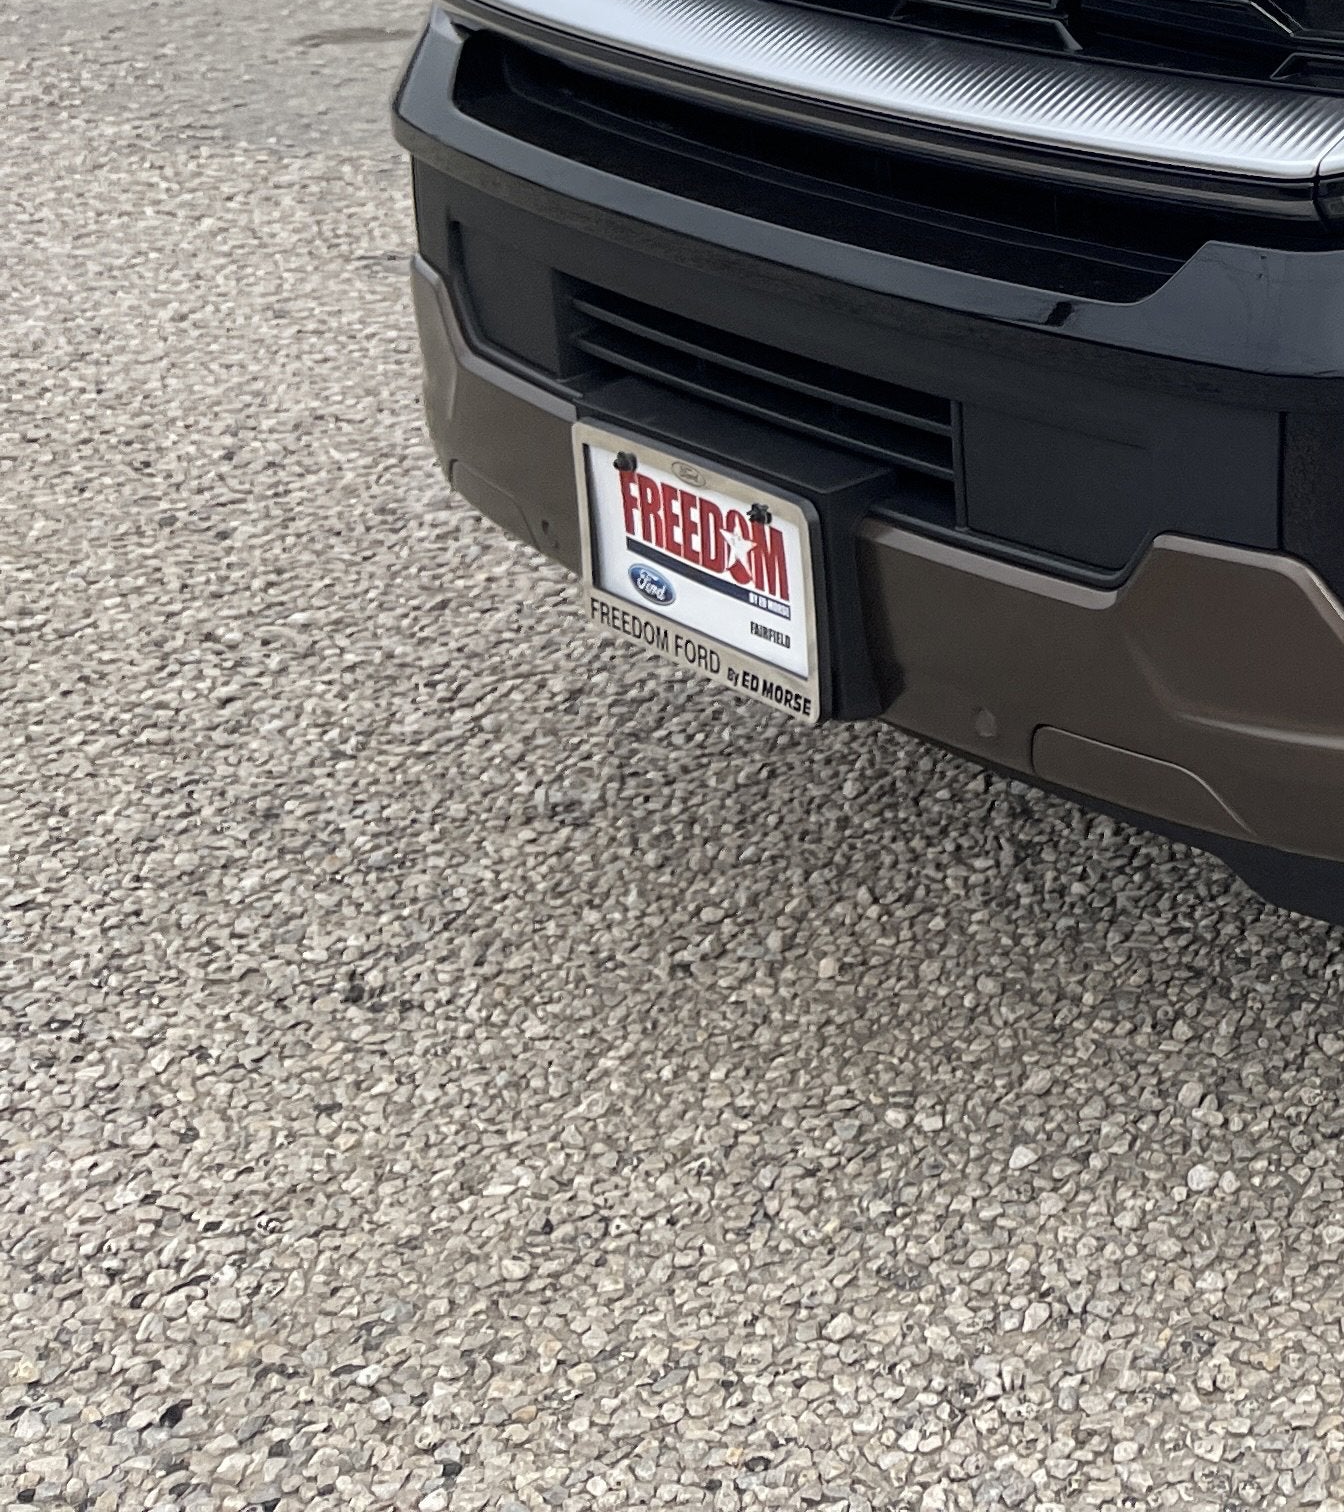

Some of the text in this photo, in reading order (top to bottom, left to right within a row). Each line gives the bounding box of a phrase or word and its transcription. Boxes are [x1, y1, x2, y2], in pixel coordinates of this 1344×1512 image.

[619, 470, 790, 602] FREEDOM
[590, 597, 670, 653] FREEDOM
[674, 634, 721, 675] FORD
[742, 670, 759, 692] ED
[762, 679, 812, 717] MORSE
